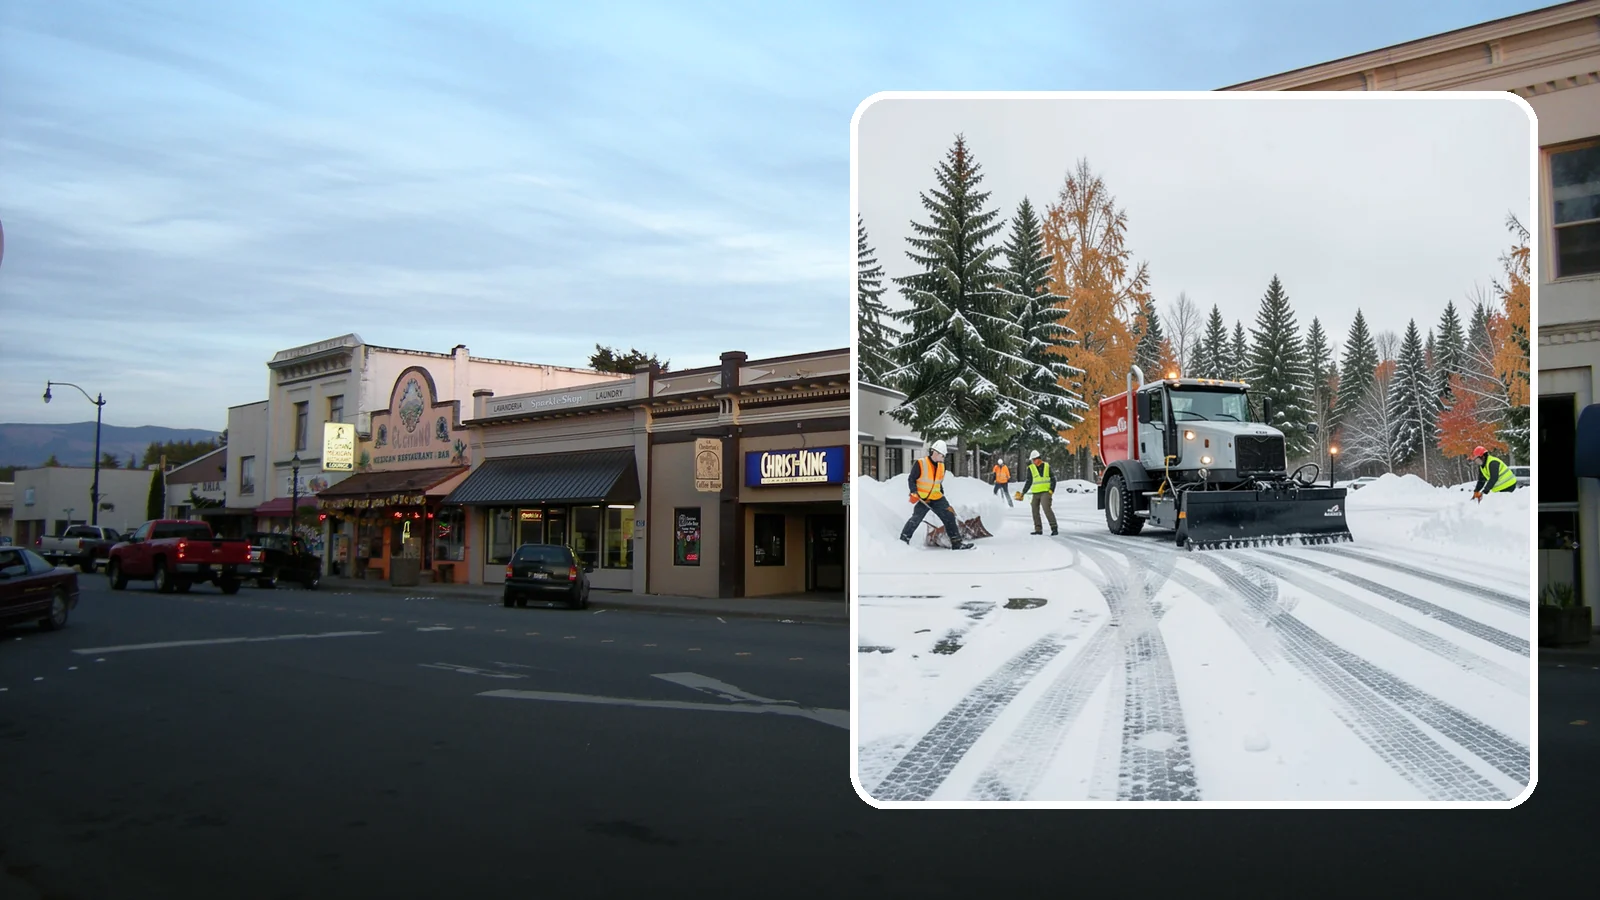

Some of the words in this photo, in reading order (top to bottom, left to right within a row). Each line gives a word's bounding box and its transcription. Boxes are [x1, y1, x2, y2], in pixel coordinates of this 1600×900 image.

[595, 388, 624, 400] LAUNDRY
[493, 402, 523, 413] LAVANDERIA
[531, 397, 560, 409] Sparkle
[561, 394, 583, 405] Shop
[374, 455, 396, 464] MEXICAN
[398, 451, 433, 462] RESTAURANT
[438, 450, 450, 459] BAR
[761, 452, 797, 478] CHRIST
[799, 450, 827, 476] KING
[710, 480, 722, 488] House
